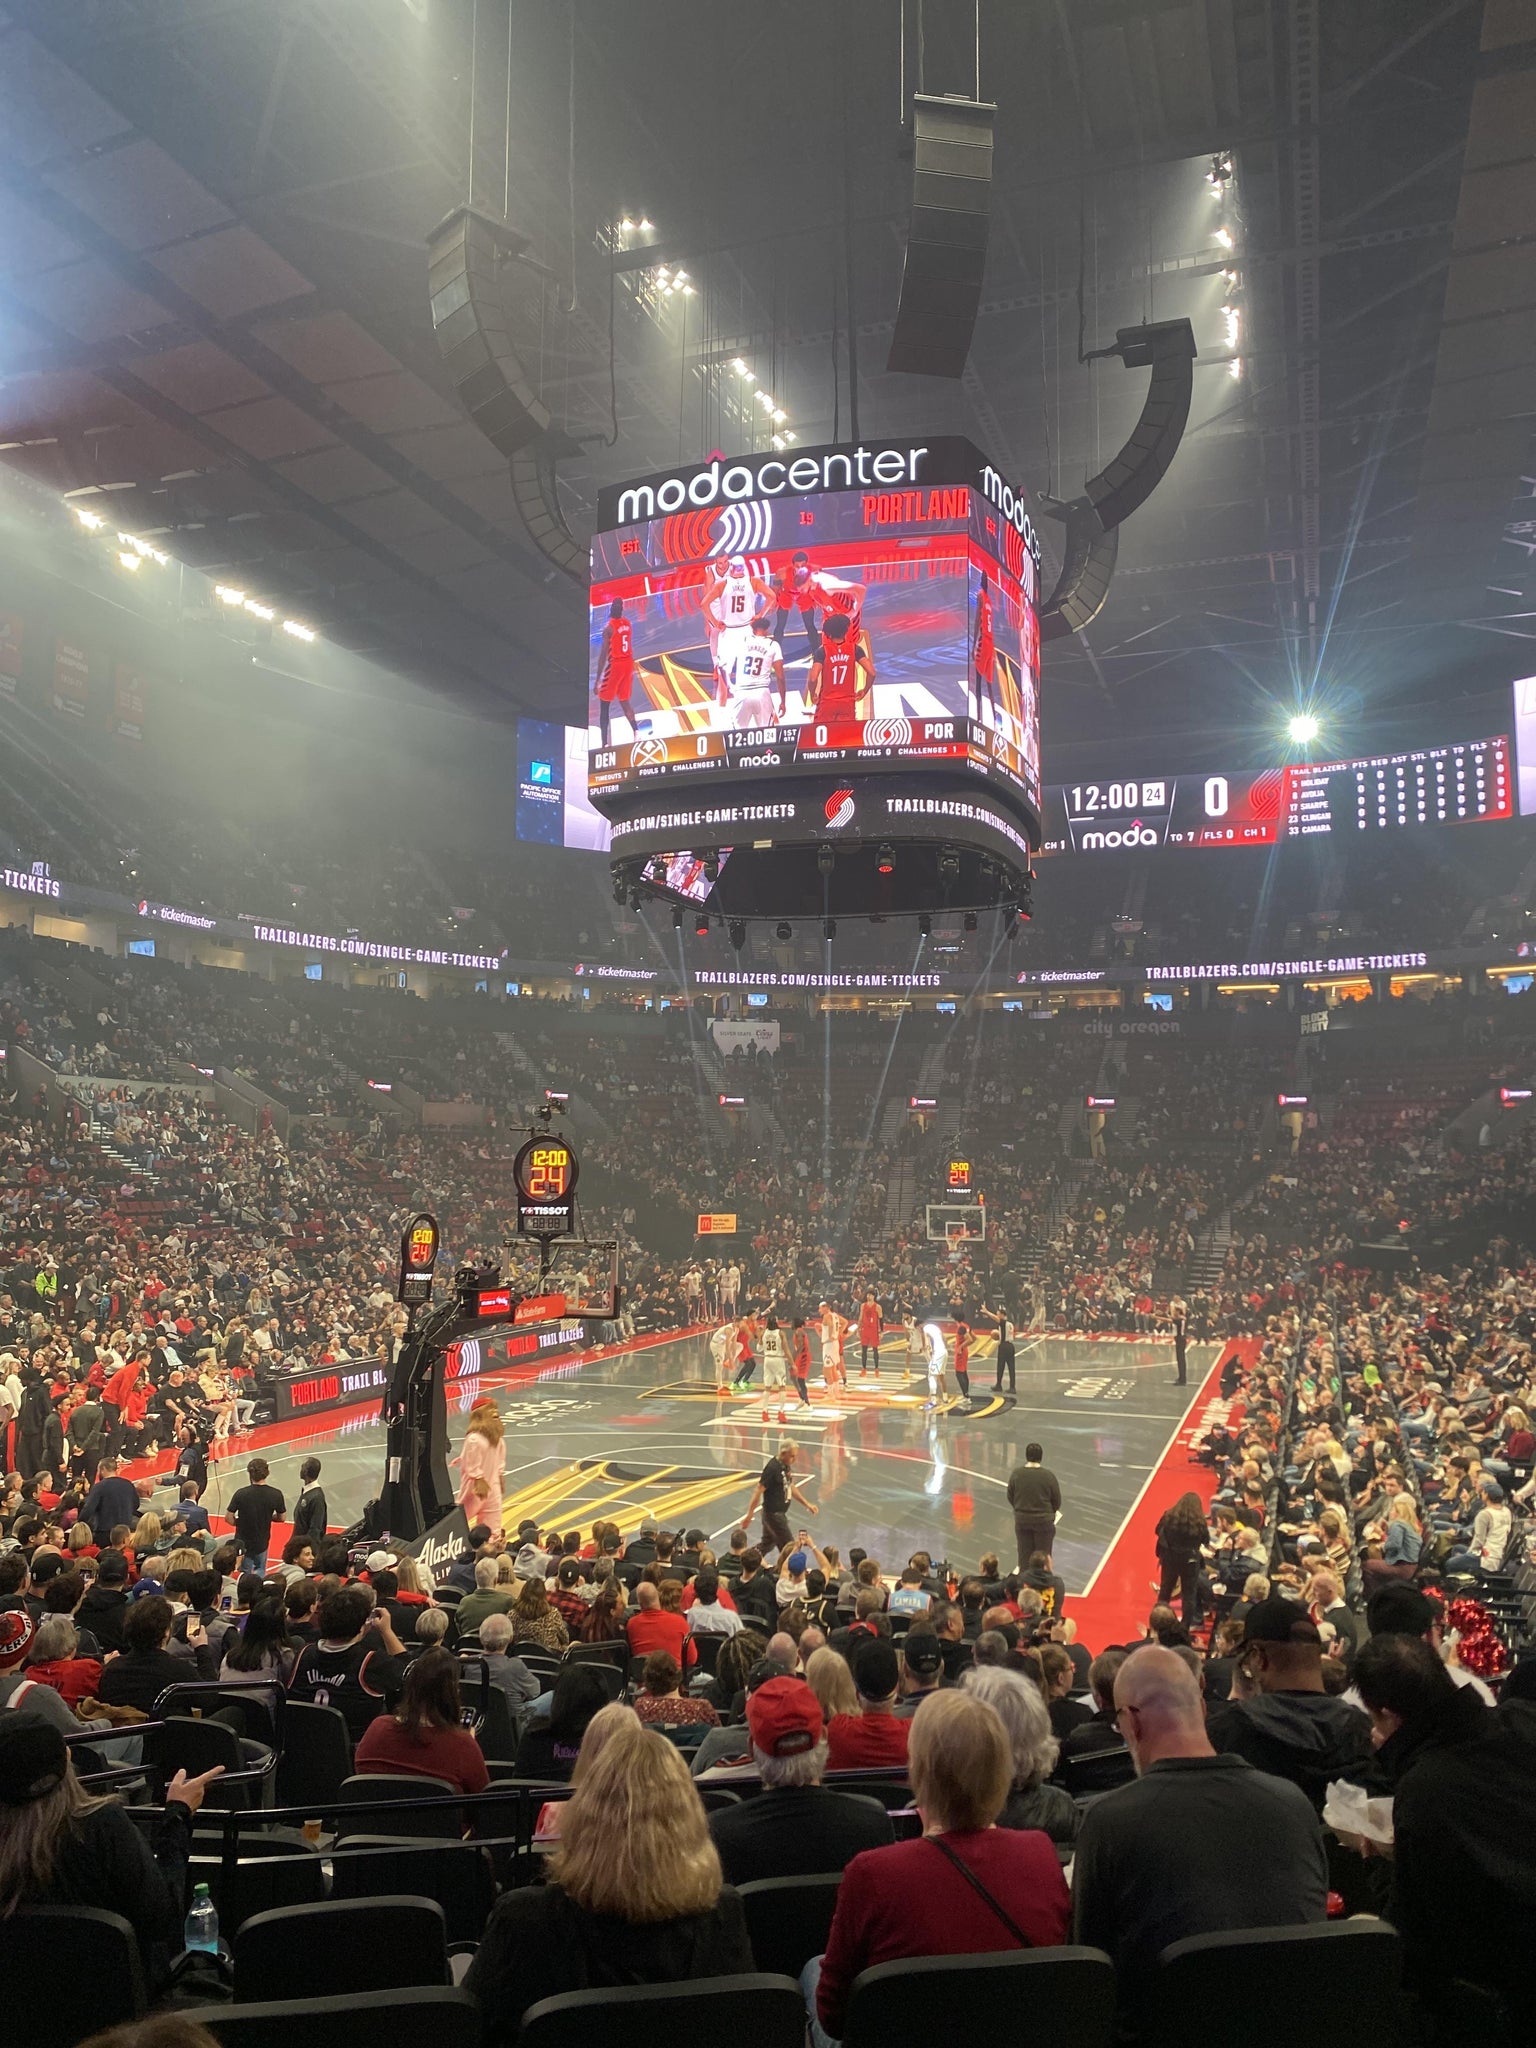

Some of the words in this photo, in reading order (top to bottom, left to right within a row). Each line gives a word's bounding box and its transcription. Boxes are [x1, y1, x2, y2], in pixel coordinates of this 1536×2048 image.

[862, 488, 969, 527] PORTLAND
[731, 595, 746, 614] 15
[621, 634, 629, 653] 5
[743, 656, 764, 676] 23
[831, 665, 848, 685] 17
[815, 724, 828, 746] 0
[924, 722, 954, 739] POR
[973, 725, 986, 747] DEN
[696, 735, 708, 757] 0
[727, 730, 763, 749] 12:00
[802, 750, 838, 760] TIMEOUTS
[841, 750, 846, 759] 7
[857, 749, 881, 757] FOULS
[885, 748, 892, 756] 0
[898, 746, 948, 755] CHALLENGES
[1290, 767, 1311, 776] TRAIL
[1312, 763, 1347, 773] BLAZERS
[1352, 761, 1368, 769] PTS
[1391, 755, 1408, 764] AST
[1410, 752, 1427, 761] STL
[1470, 742, 1488, 751] FLS
[594, 751, 617, 769] DEN
[672, 761, 716, 773] CHALLENGES
[739, 752, 781, 768] moda
[639, 767, 659, 776] FOULS
[1071, 782, 1138, 811] 12:00
[1146, 787, 1161, 801] 24
[1204, 776, 1228, 817] 0
[1288, 815, 1298, 823] 23
[1082, 826, 1158, 850] moda
[1170, 833, 1183, 842] TO
[1188, 831, 1195, 841] 7
[1204, 830, 1223, 840] FLS
[1226, 828, 1234, 840] 0
[1244, 828, 1257, 837] CH
[1260, 827, 1266, 837] 1
[1044, 841, 1058, 850] CH
[1060, 839, 1066, 850] 1
[161, 907, 214, 929] ticketmaster
[253, 925, 500, 970] TRAILBLAZERS.COM/SINGLE-GAME-TICKETS
[598, 967, 654, 979] ticketmaster
[1146, 953, 1427, 979] TRAILBLAZERS.COM/SINGLE-GAME-TICKETS
[695, 971, 941, 986] TRAILBLAZERS.COM/SINGLE-GAME-TICKETS
[1041, 970, 1101, 982] ticketmaster
[1300, 1010, 1329, 1025] BLOCK
[1300, 1020, 1329, 1035] PARTY
[533, 1150, 567, 1166] 12:00
[951, 1162, 969, 1171] 12:00
[529, 1166, 564, 1194] 24
[949, 1170, 968, 1184] 24
[534, 1206, 569, 1215] TISSOT
[410, 1244, 429, 1262] 24
[539, 1332, 558, 1348] TRAIL
[559, 1327, 584, 1344] BLAZERS
[766, 1340, 778, 1351] 32
[290, 1375, 340, 1407] PORTLAND
[342, 1372, 371, 1392] TRAIL
